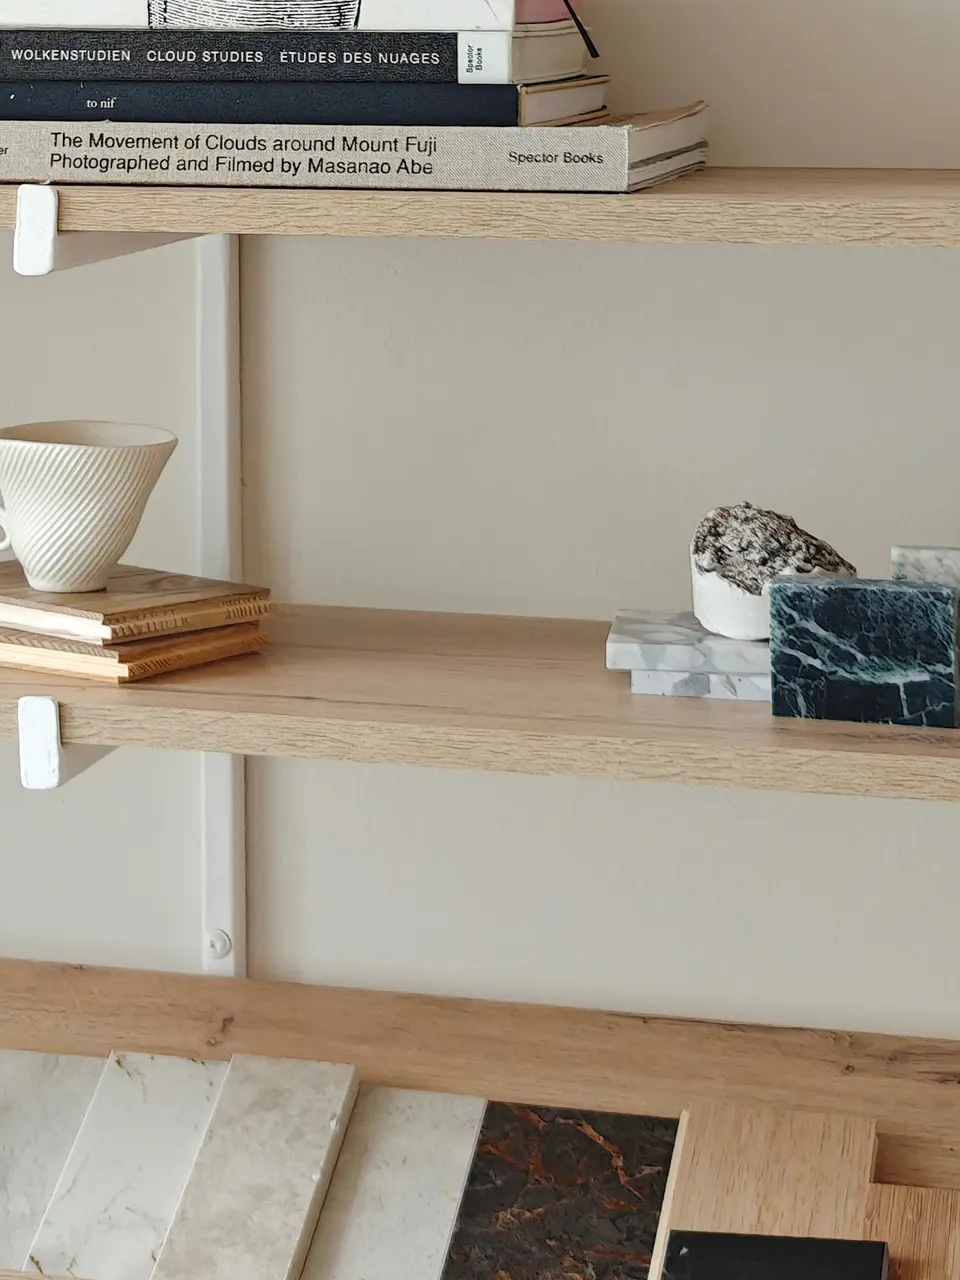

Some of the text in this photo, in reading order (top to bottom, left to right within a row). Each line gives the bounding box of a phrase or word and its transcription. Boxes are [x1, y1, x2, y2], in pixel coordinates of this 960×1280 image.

[10, 49, 131, 61] WOLKENSTUDIEN
[146, 50, 196, 62] CLOUD
[202, 50, 264, 63] STUDIES
[343, 52, 372, 64] DES
[378, 52, 440, 65] NUAGES
[86, 97, 117, 109] to nif
[50, 132, 438, 156] The Movement of Clouds around Mount Fuji
[50, 153, 433, 176] Photographed and Filmed by Masanao Abe
[508, 150, 604, 165] Spector Books
